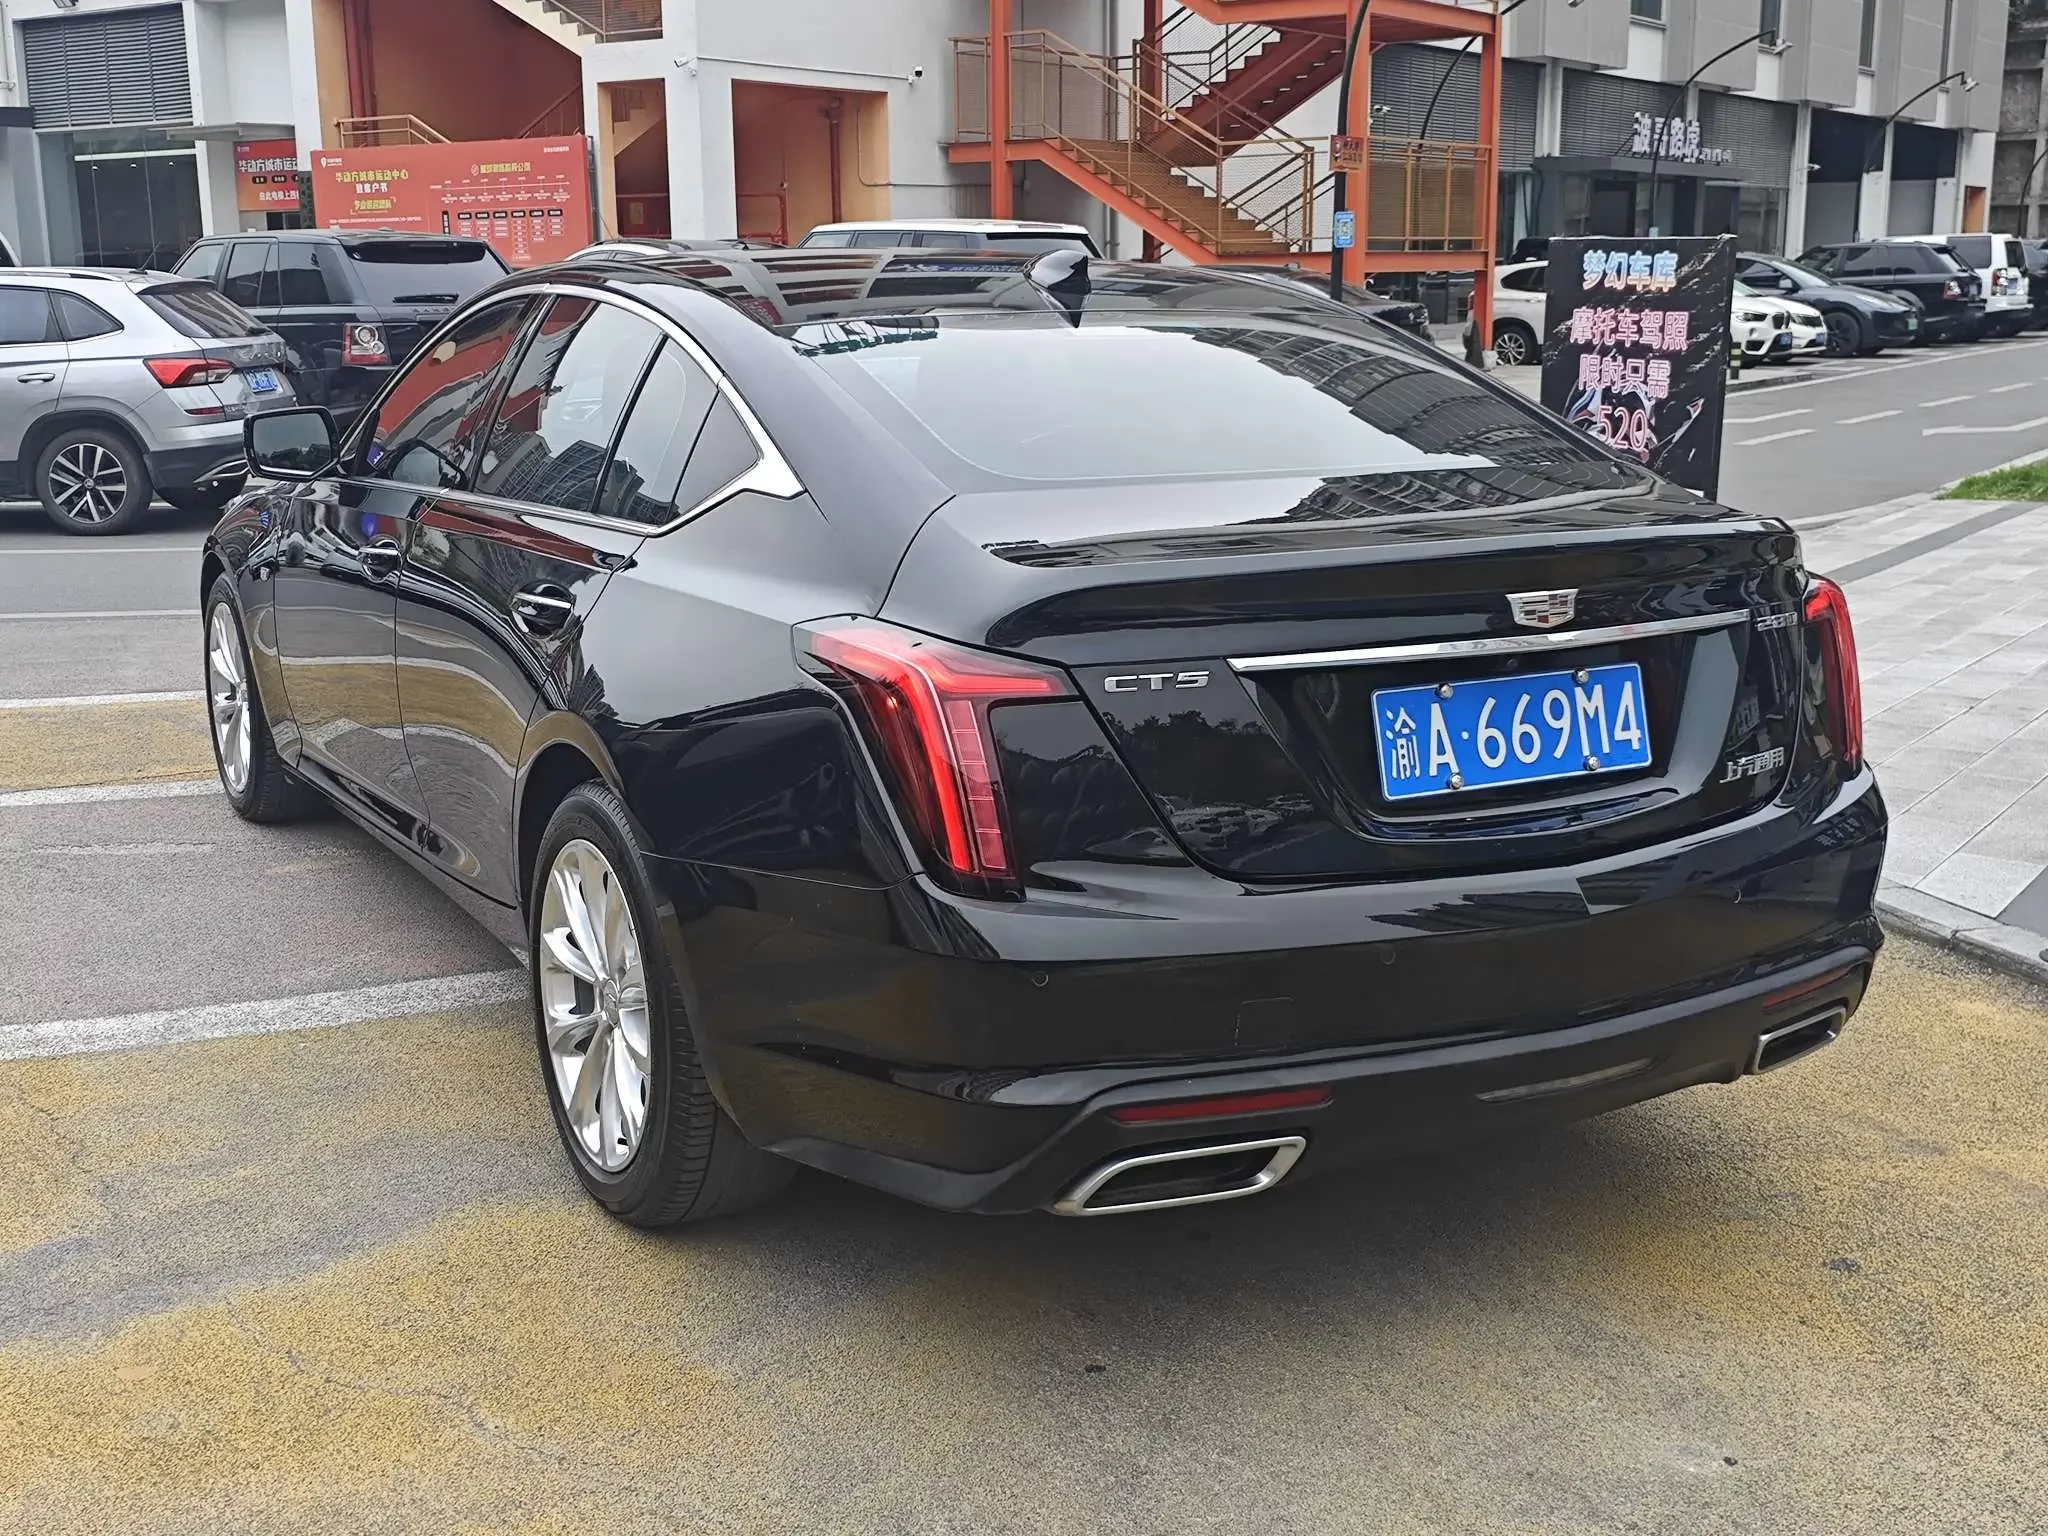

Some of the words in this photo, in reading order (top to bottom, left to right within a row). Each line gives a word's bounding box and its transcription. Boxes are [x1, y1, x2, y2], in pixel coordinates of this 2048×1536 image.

[1583, 250, 1678, 292] 梦幻车库
[1569, 307, 1689, 350] 摩托车驾照
[1578, 354, 1671, 399] 限时只需
[1597, 405, 1649, 451] 520
[1104, 671, 1210, 693] CT5
[1719, 747, 1784, 784] 上汽通用
